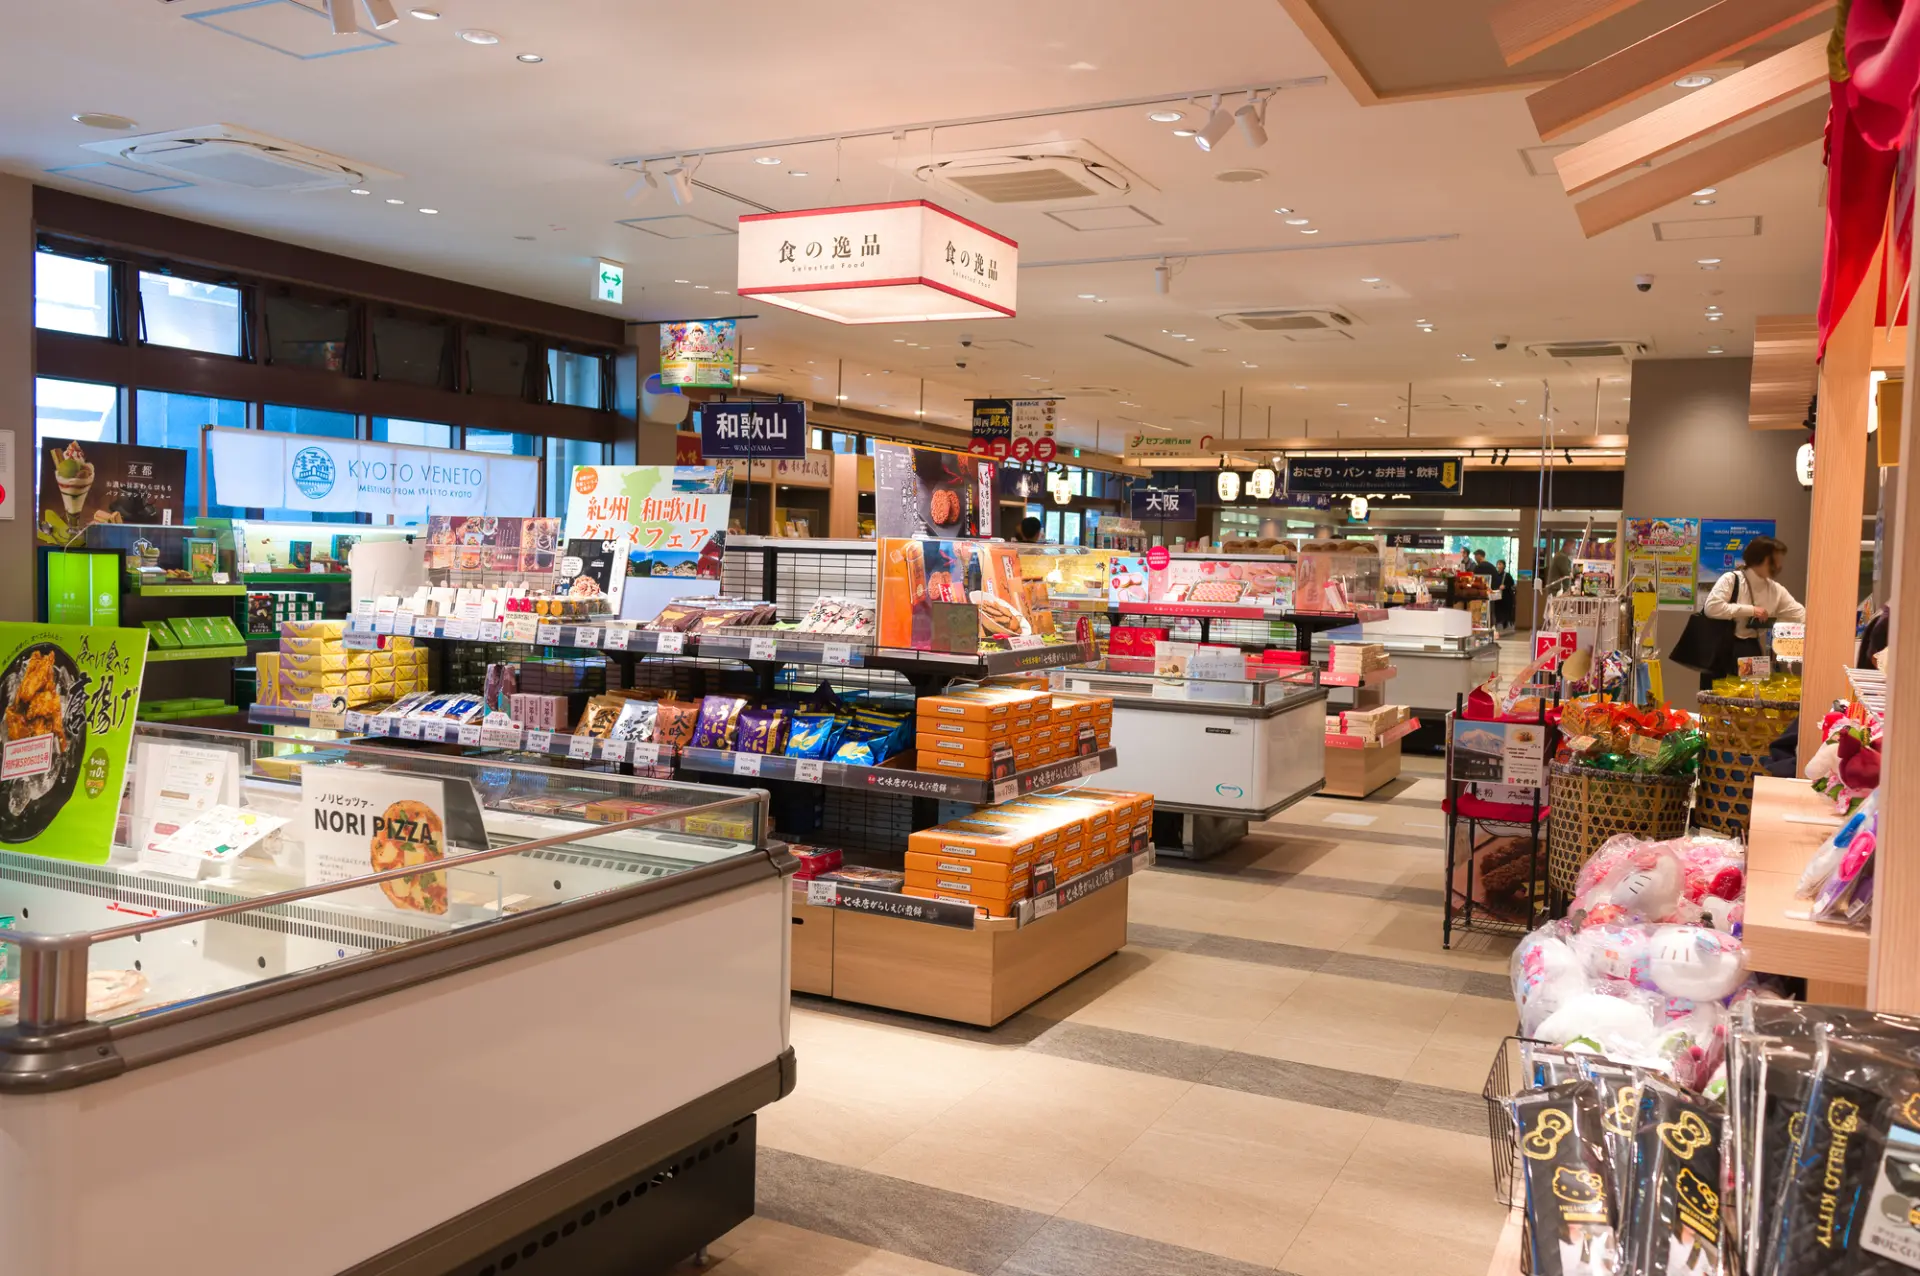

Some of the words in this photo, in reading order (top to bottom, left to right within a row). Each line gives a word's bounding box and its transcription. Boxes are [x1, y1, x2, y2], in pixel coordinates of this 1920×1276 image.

[779, 233, 881, 263] 食の逸品
[945, 240, 998, 281] 食の逸品
[792, 263, 835, 272] Selected
[841, 261, 865, 269] Food
[716, 412, 787, 440] 和歌山
[994, 443, 1052, 458] コチラ
[128, 465, 152, 476] 京都
[348, 460, 413, 482] KYOTO
[421, 465, 482, 486] VENETO
[1293, 466, 1439, 478] おにぎり・パン・お弁当・飲料
[394, 486, 415, 495] FROM
[438, 488, 448, 497] TO
[450, 489, 472, 498] KYOTO
[1146, 494, 1179, 511] 大阪
[587, 496, 629, 521] 紀州
[641, 497, 706, 523] 和歌山
[581, 524, 710, 549] グルメフェア
[76, 635, 130, 676] 冷やして食べる
[67, 672, 139, 735] 唐揚げ
[711, 704, 729, 735] うに
[752, 720, 768, 752] うに
[314, 808, 366, 836] NORI
[373, 816, 433, 845] PIZZA
[1824, 1132, 1848, 1190] HELLO
[1817, 1192, 1837, 1249] KITTY
